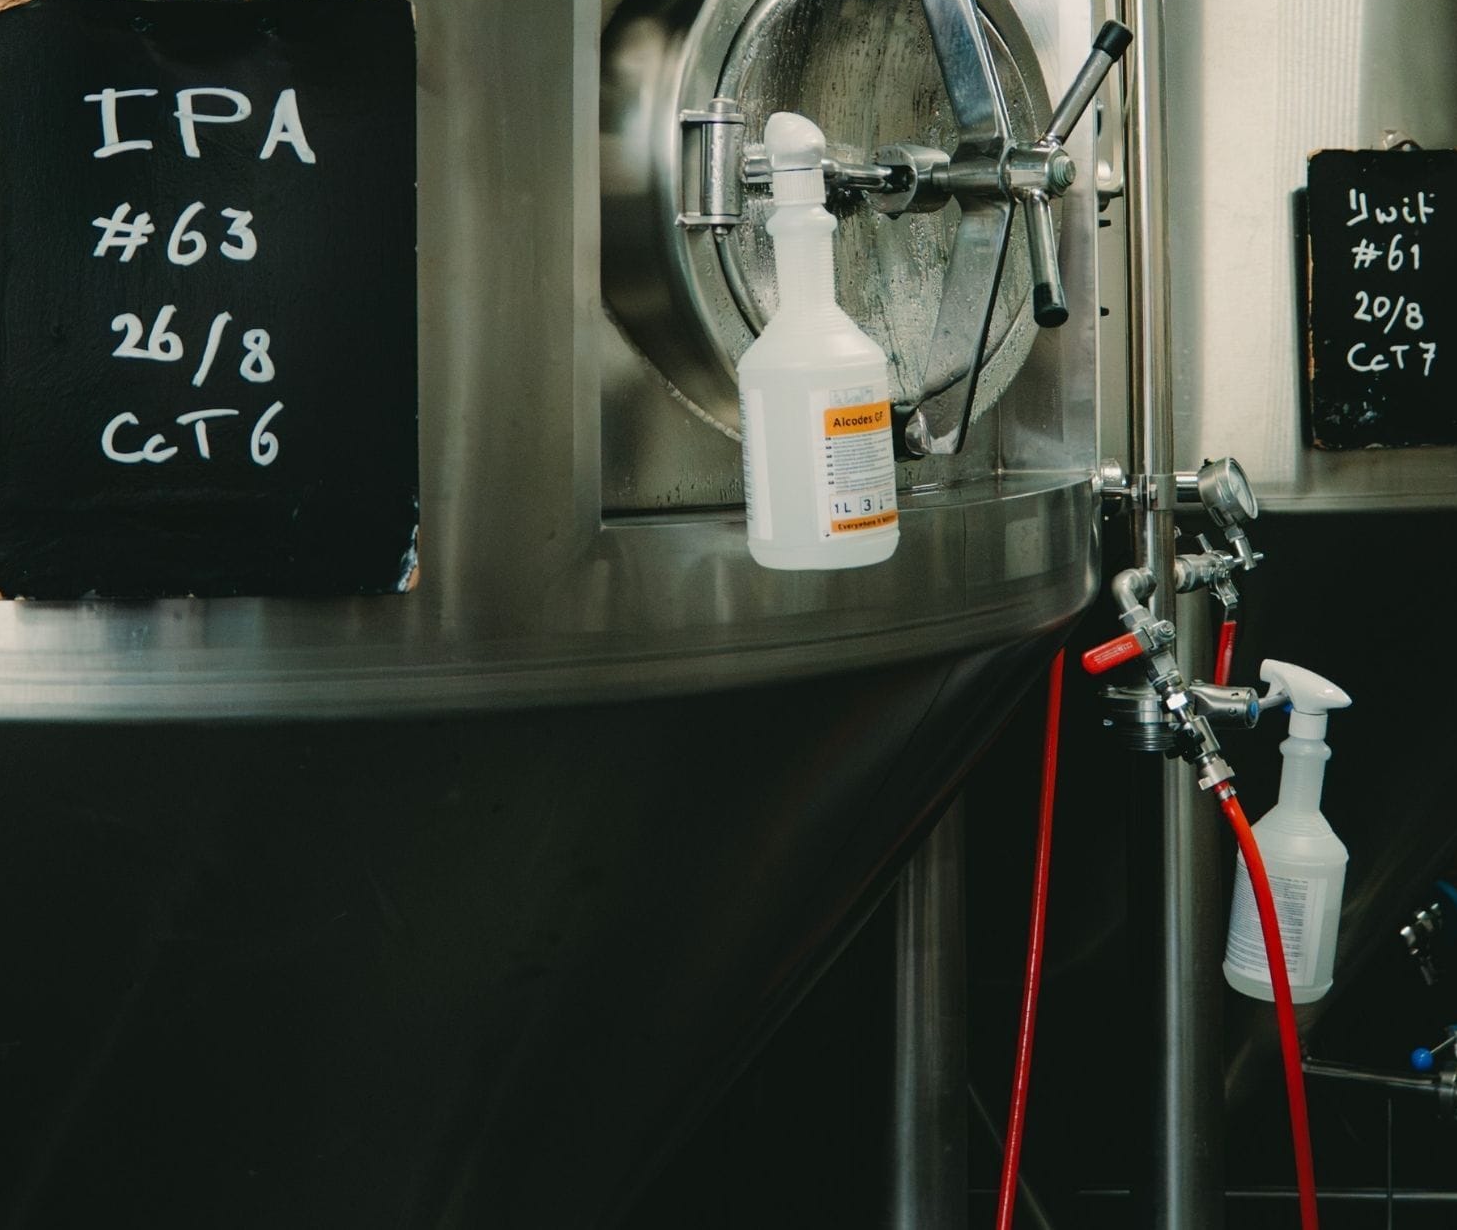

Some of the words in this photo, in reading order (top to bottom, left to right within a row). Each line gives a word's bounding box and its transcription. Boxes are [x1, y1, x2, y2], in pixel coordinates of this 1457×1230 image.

[84, 87, 317, 165] IPA
[91, 201, 258, 266] #63
[1351, 233, 1420, 272] #61
[1353, 290, 1425, 335] 20/8
[111, 304, 276, 387] 26/8
[833, 415, 873, 428] Alcodes
[863, 498, 872, 512] 3
